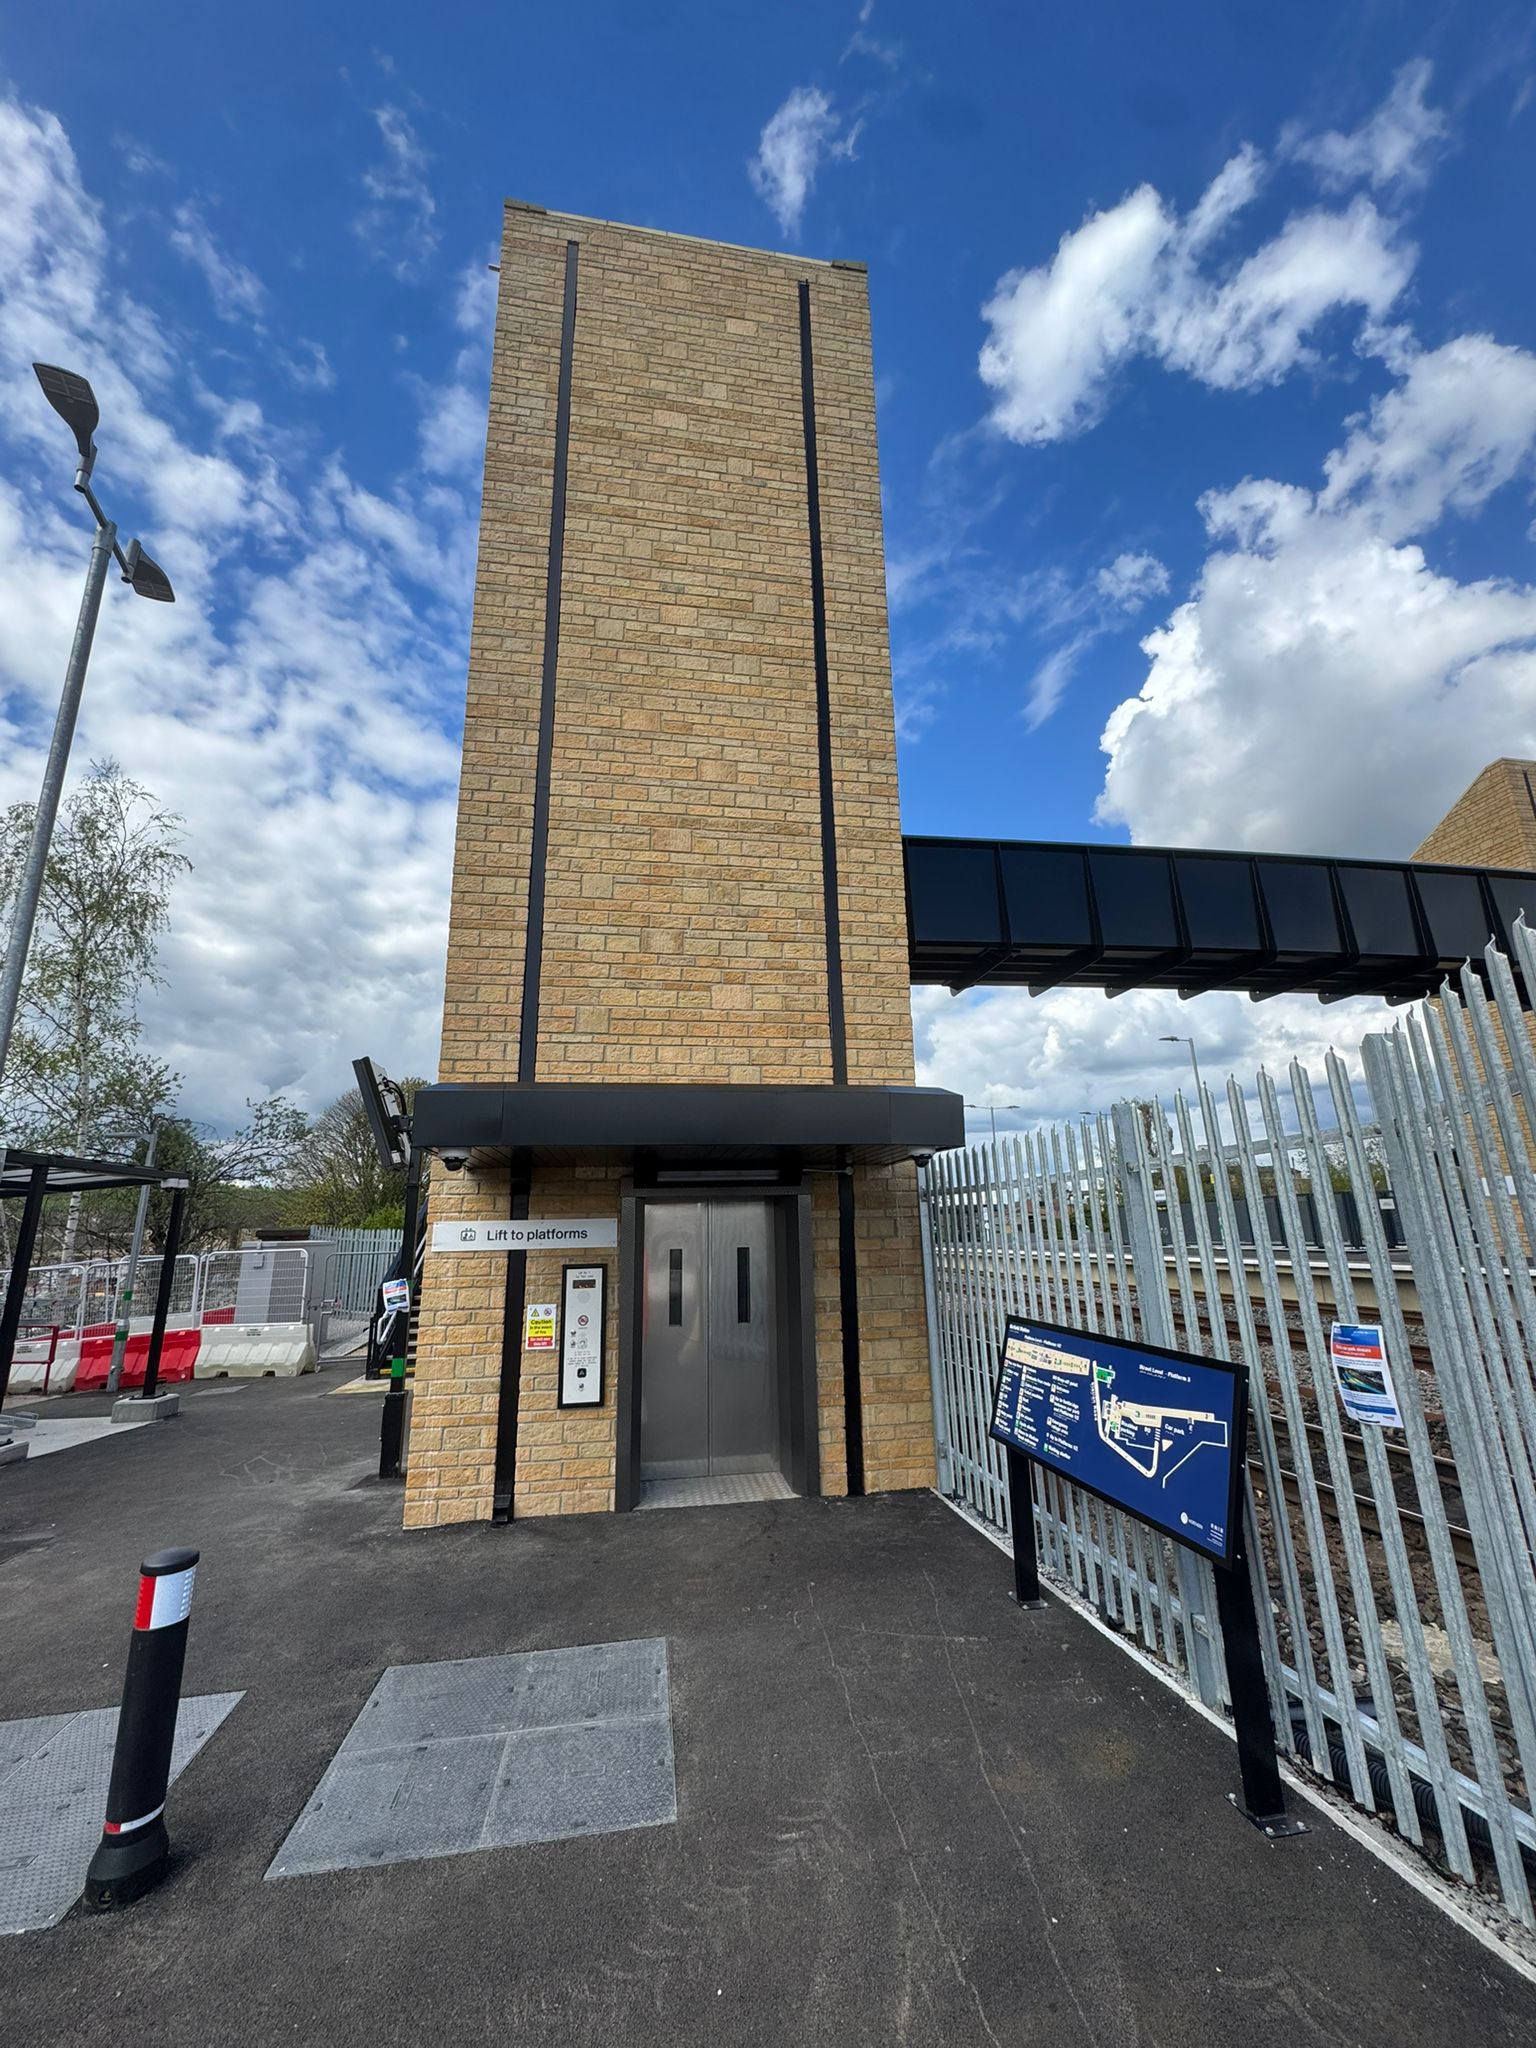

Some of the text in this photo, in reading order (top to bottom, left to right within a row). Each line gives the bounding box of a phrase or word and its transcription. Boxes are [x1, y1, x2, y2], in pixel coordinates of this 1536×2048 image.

[487, 1228, 588, 1242] Lift to platforms
